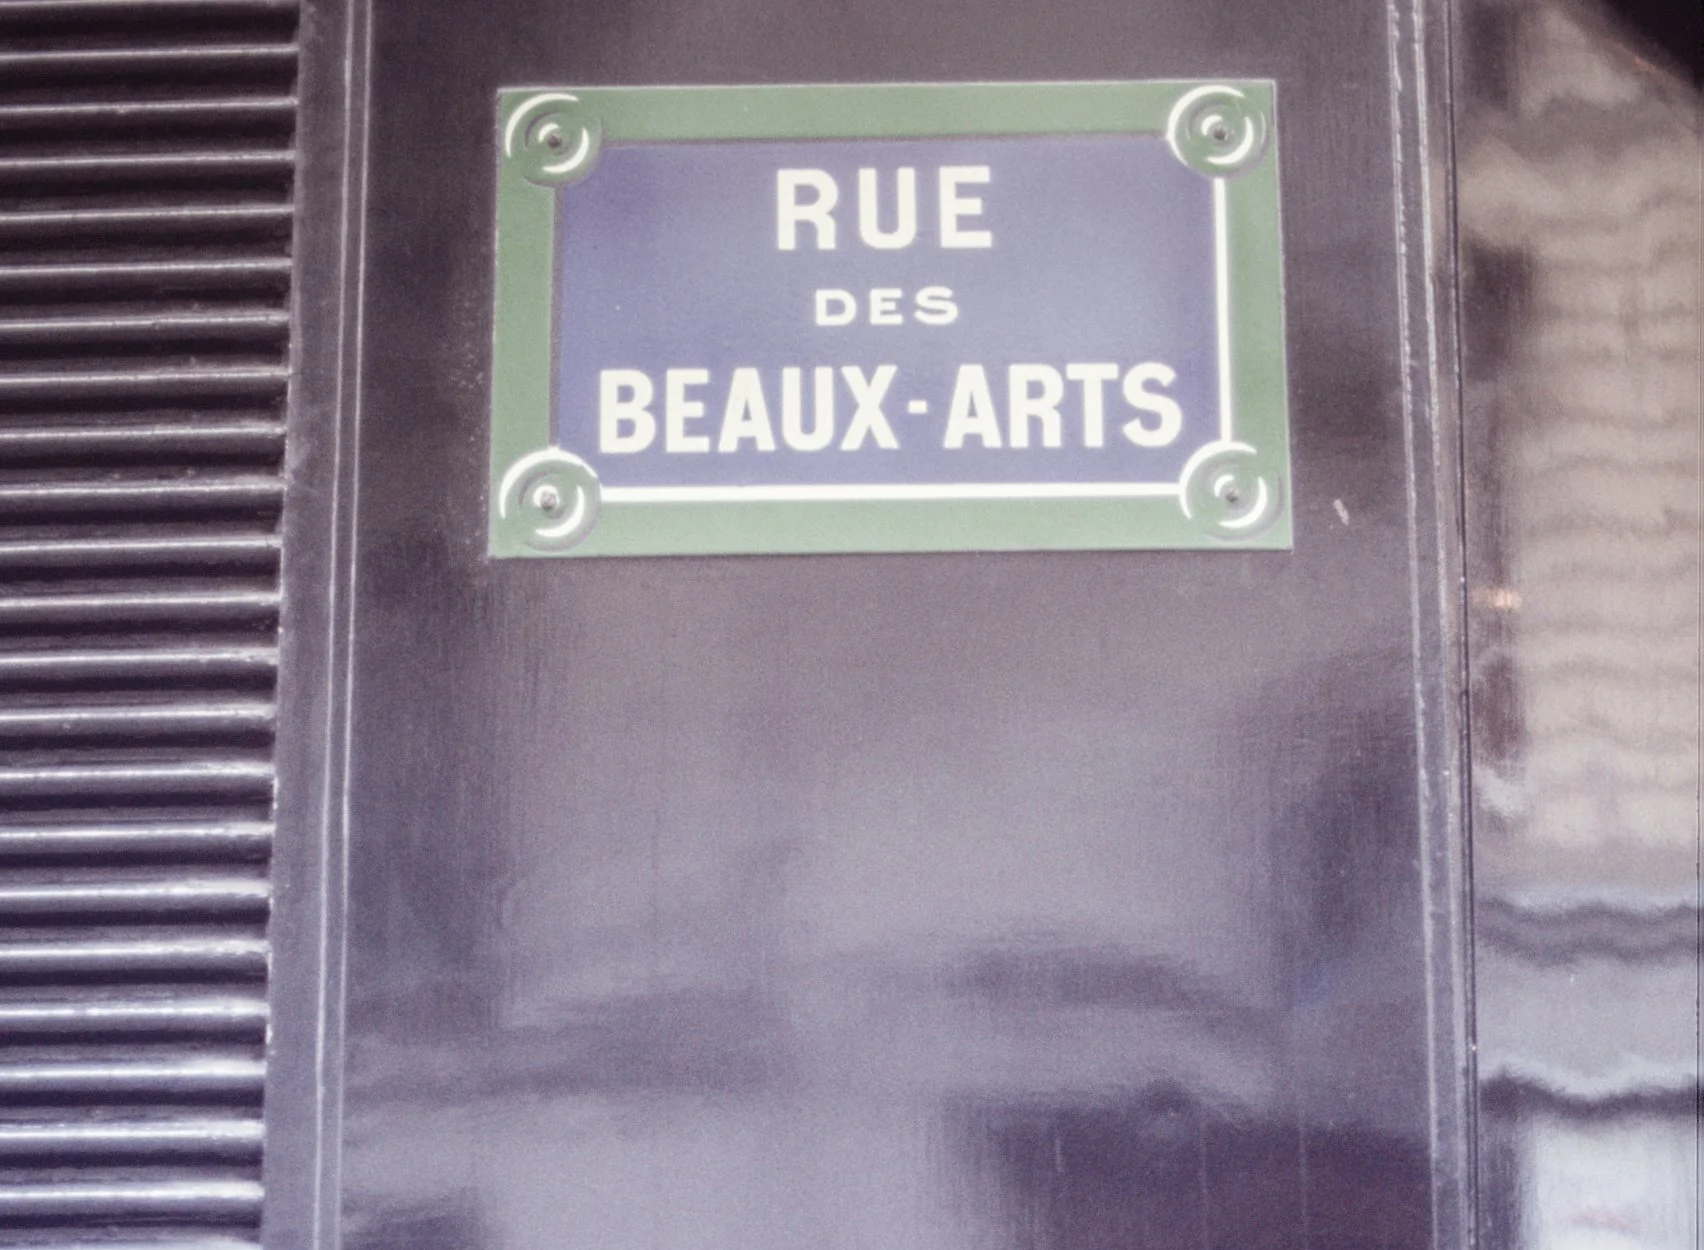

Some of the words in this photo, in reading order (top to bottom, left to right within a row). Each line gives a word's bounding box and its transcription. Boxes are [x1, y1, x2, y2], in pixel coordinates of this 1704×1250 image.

[775, 165, 996, 251] RUE
[813, 286, 960, 328] DES
[597, 362, 1184, 456] BEAUX-ARTS
